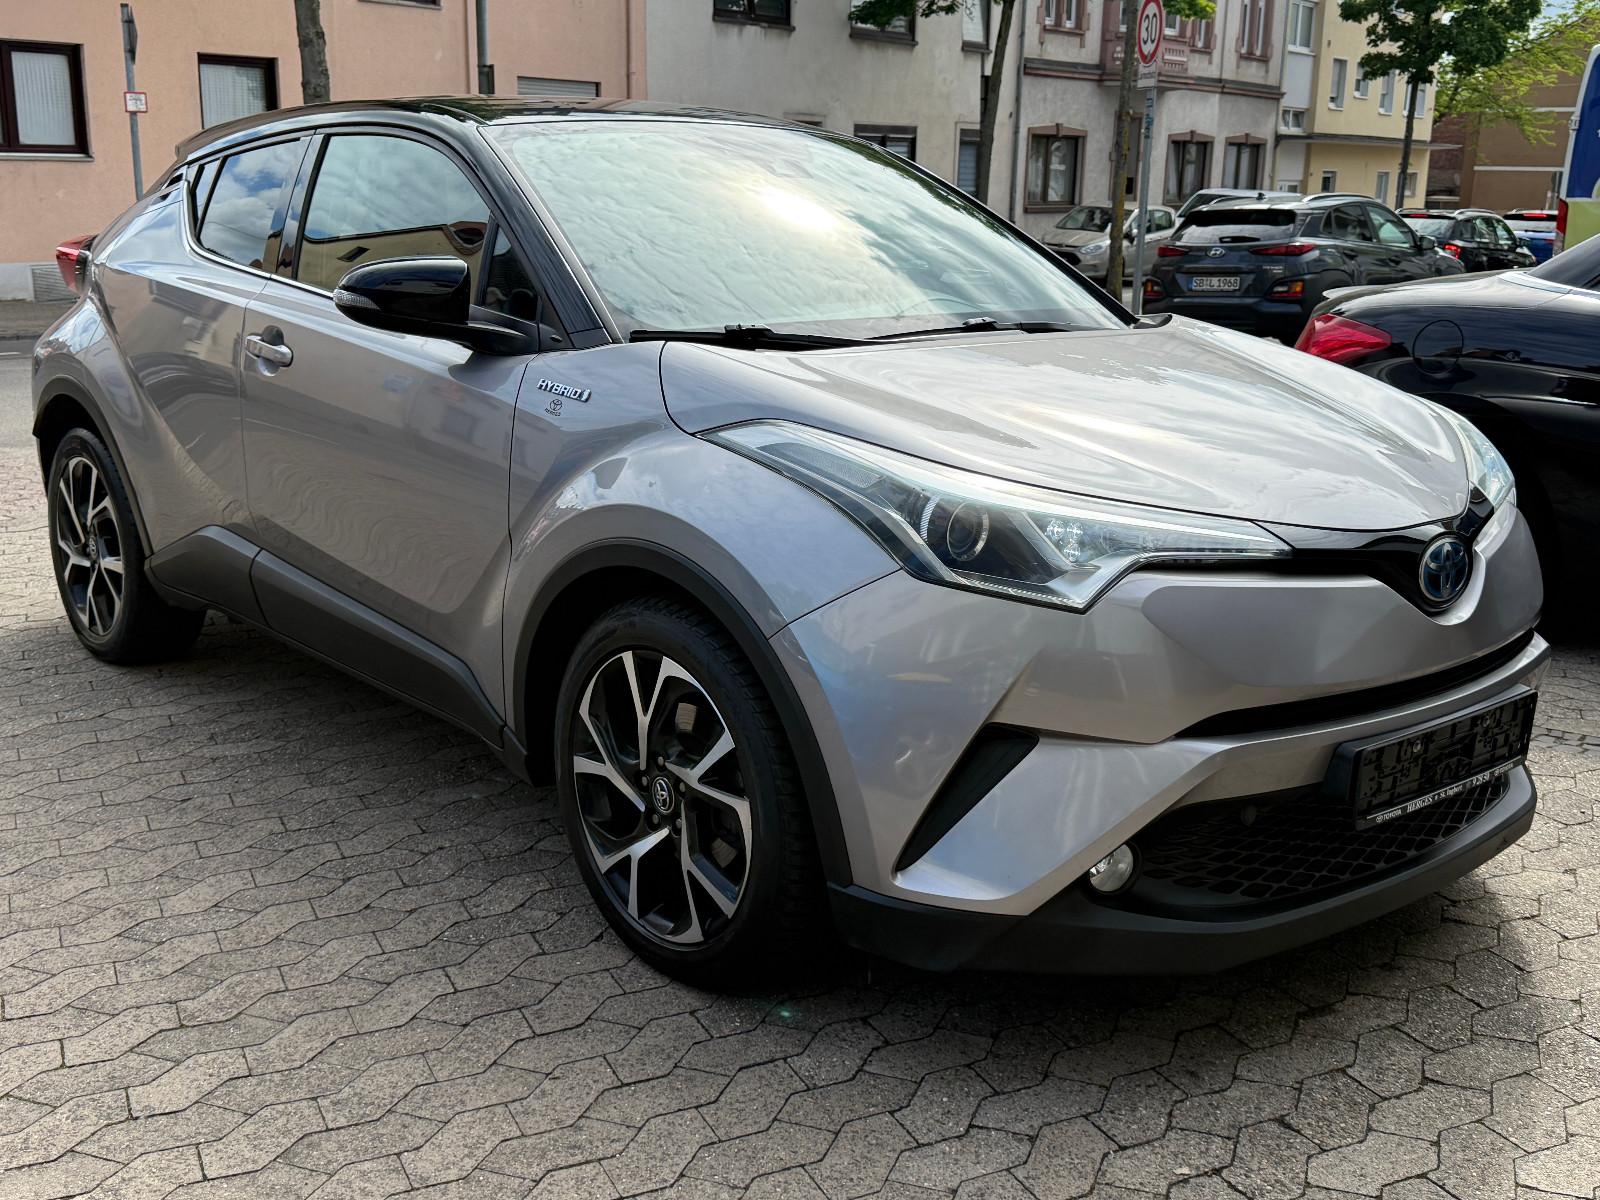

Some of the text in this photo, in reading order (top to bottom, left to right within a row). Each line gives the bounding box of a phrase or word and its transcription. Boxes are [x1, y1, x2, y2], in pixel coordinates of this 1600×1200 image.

[1143, 13, 1158, 45] 30
[1194, 278, 1205, 288] SB
[1216, 278, 1239, 288] 1968
[536, 378, 581, 399] HYBRID
[1383, 809, 1402, 821] TOYOTA
[1406, 795, 1433, 813] HERGES
